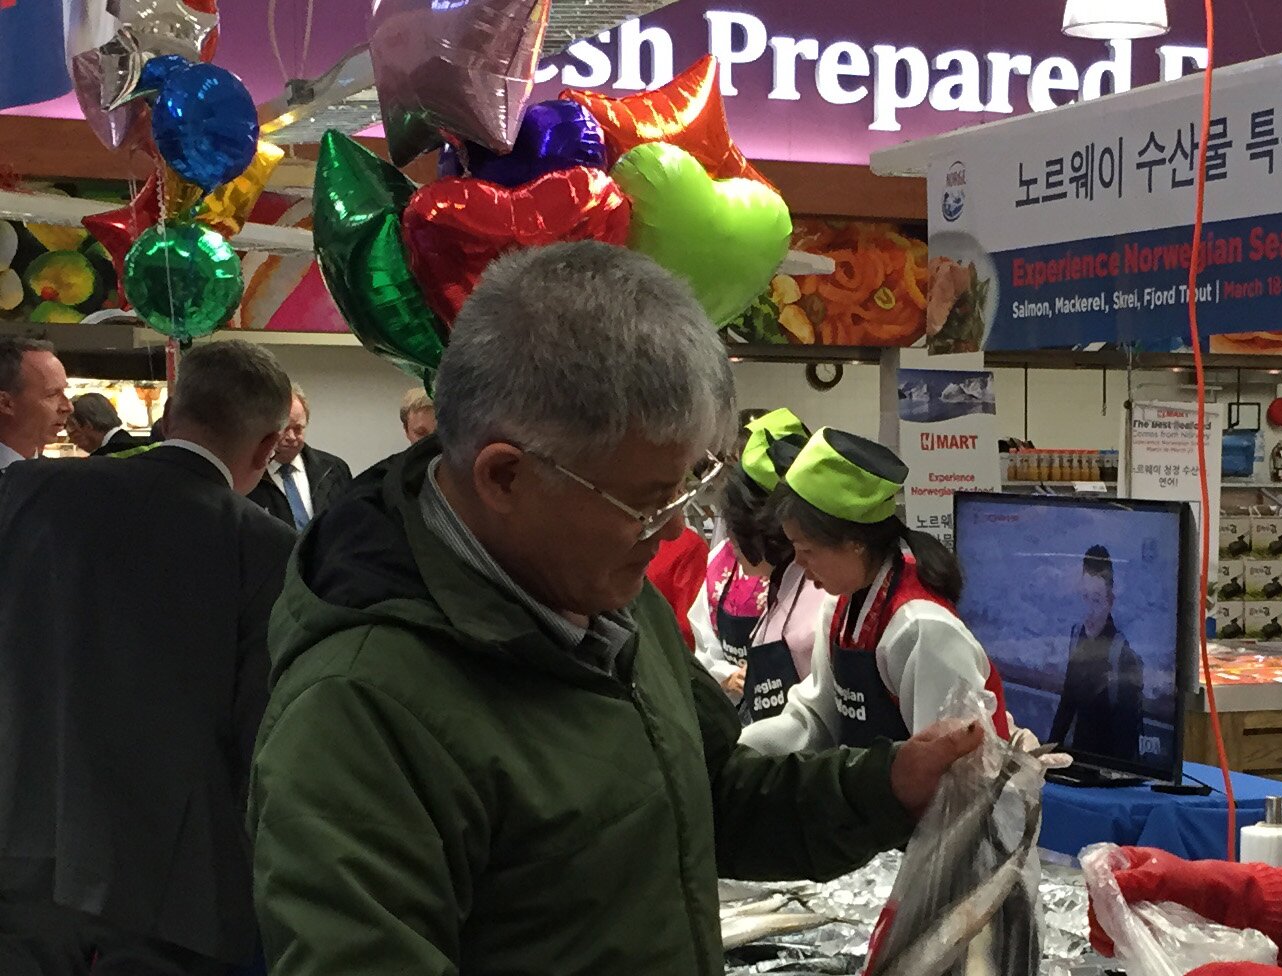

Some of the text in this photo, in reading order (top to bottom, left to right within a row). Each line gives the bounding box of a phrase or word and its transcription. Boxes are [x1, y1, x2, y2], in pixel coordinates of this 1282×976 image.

[534, 9, 1132, 131] sh Prepared
[1015, 137, 1123, 208] 노르웨이
[1136, 117, 1233, 194] 수산물
[1012, 250, 1120, 289] Experience
[1012, 297, 1053, 320] Salmon,
[1055, 292, 1109, 314] Mackerel,
[1113, 289, 1141, 311] Skrei,
[1143, 286, 1175, 310] Fjord
[1224, 279, 1262, 299] March
[937, 435, 978, 449] MART
[928, 472, 975, 483] Experience
